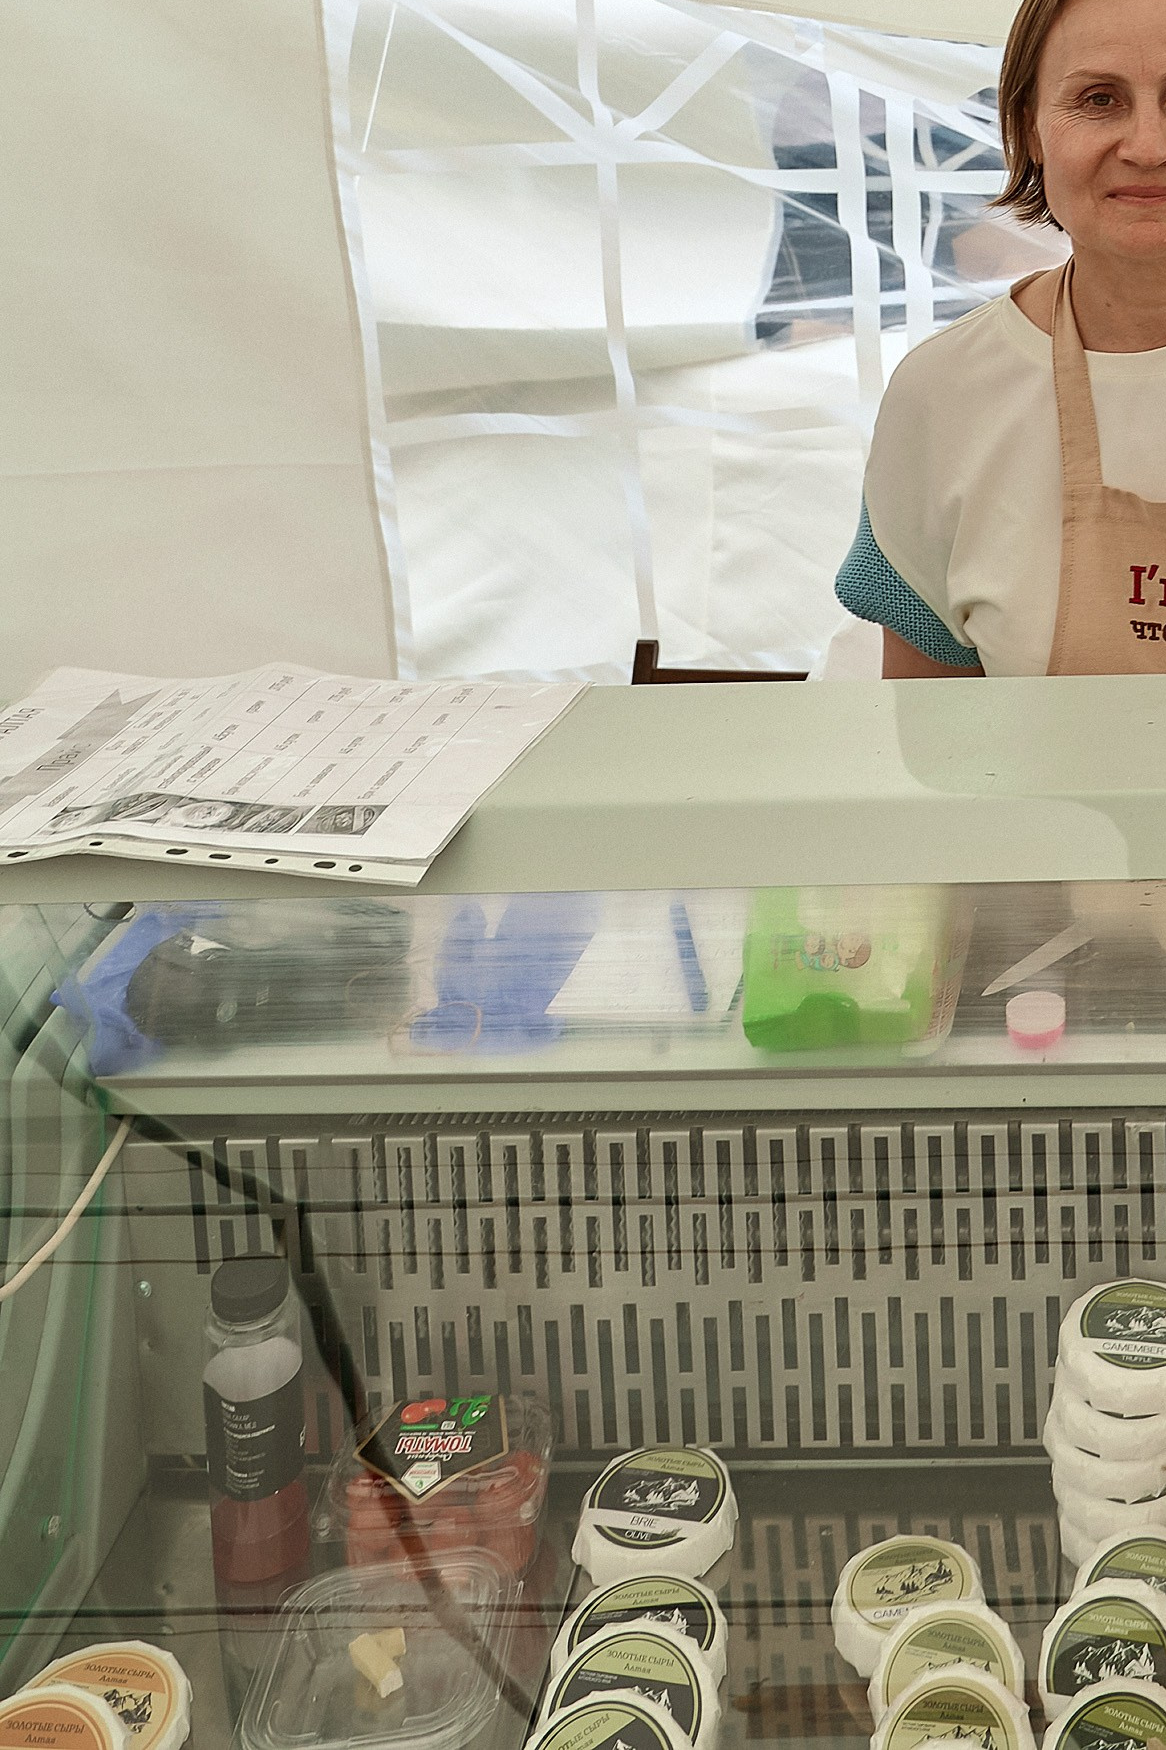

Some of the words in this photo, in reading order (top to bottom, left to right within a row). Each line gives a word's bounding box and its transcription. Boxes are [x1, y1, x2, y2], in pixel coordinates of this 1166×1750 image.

[395, 1435, 473, 1454] ТОМАТЫ
[630, 1515, 659, 1529] BRIE
[1089, 1613, 1124, 1626] ЗОЛОТЫЕ
[1124, 1618, 1149, 1630] СЫРЫ
[1104, 1625, 1129, 1635] Алтая
[606, 1649, 647, 1663] ЗОЛОТЫЕ
[648, 1654, 675, 1667] СЫРЫ
[84, 1662, 126, 1675] ЗОЛОТЫЕ
[126, 1668, 155, 1679] СЫРЫ
[624, 1663, 651, 1674] Алтая
[99, 1675, 128, 1684] Алтая
[583, 1713, 610, 1736] СЫРЫ
[1104, 1706, 1140, 1725] ЗОЛОТЫЕ
[1139, 1715, 1165, 1732] СЫРЫ
[5, 1720, 52, 1731] ЗОЛОТЫЕ
[53, 1722, 85, 1734] СЫРЫ
[1119, 1722, 1144, 1736] Алтая
[25, 1734, 56, 1744] Алтая
